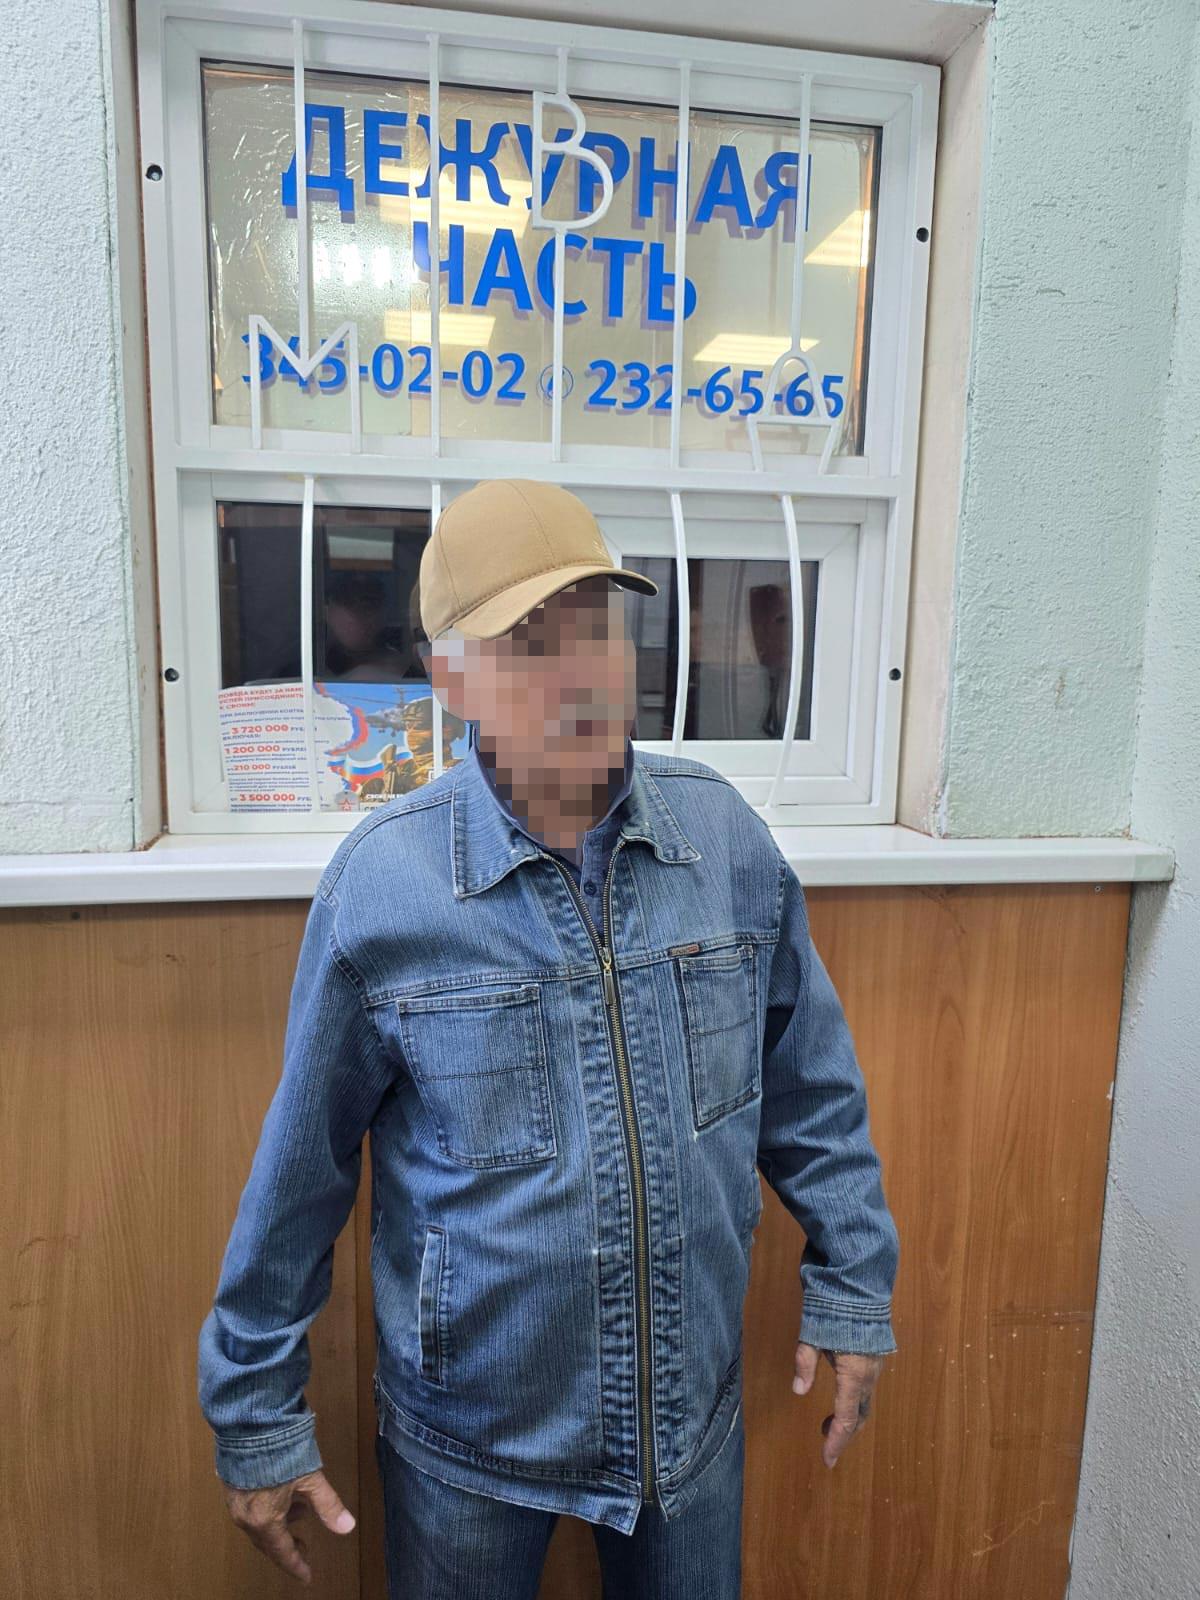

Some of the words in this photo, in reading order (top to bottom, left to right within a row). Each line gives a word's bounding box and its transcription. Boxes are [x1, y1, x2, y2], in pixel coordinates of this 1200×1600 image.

[282, 103, 812, 233] ДЕЖУРНАЯ
[412, 220, 698, 324] ЧАСТЬ
[241, 333, 527, 400] 345-02-02
[588, 359, 844, 418] 232-65-65
[244, 693, 304, 701] ПРИСОЕДИНИТЬ
[231, 726, 239, 735] 3
[240, 725, 262, 734] 720
[265, 724, 289, 732] 000
[231, 746, 255, 754] 200
[257, 744, 280, 753] 000
[273, 793, 296, 801] 000
